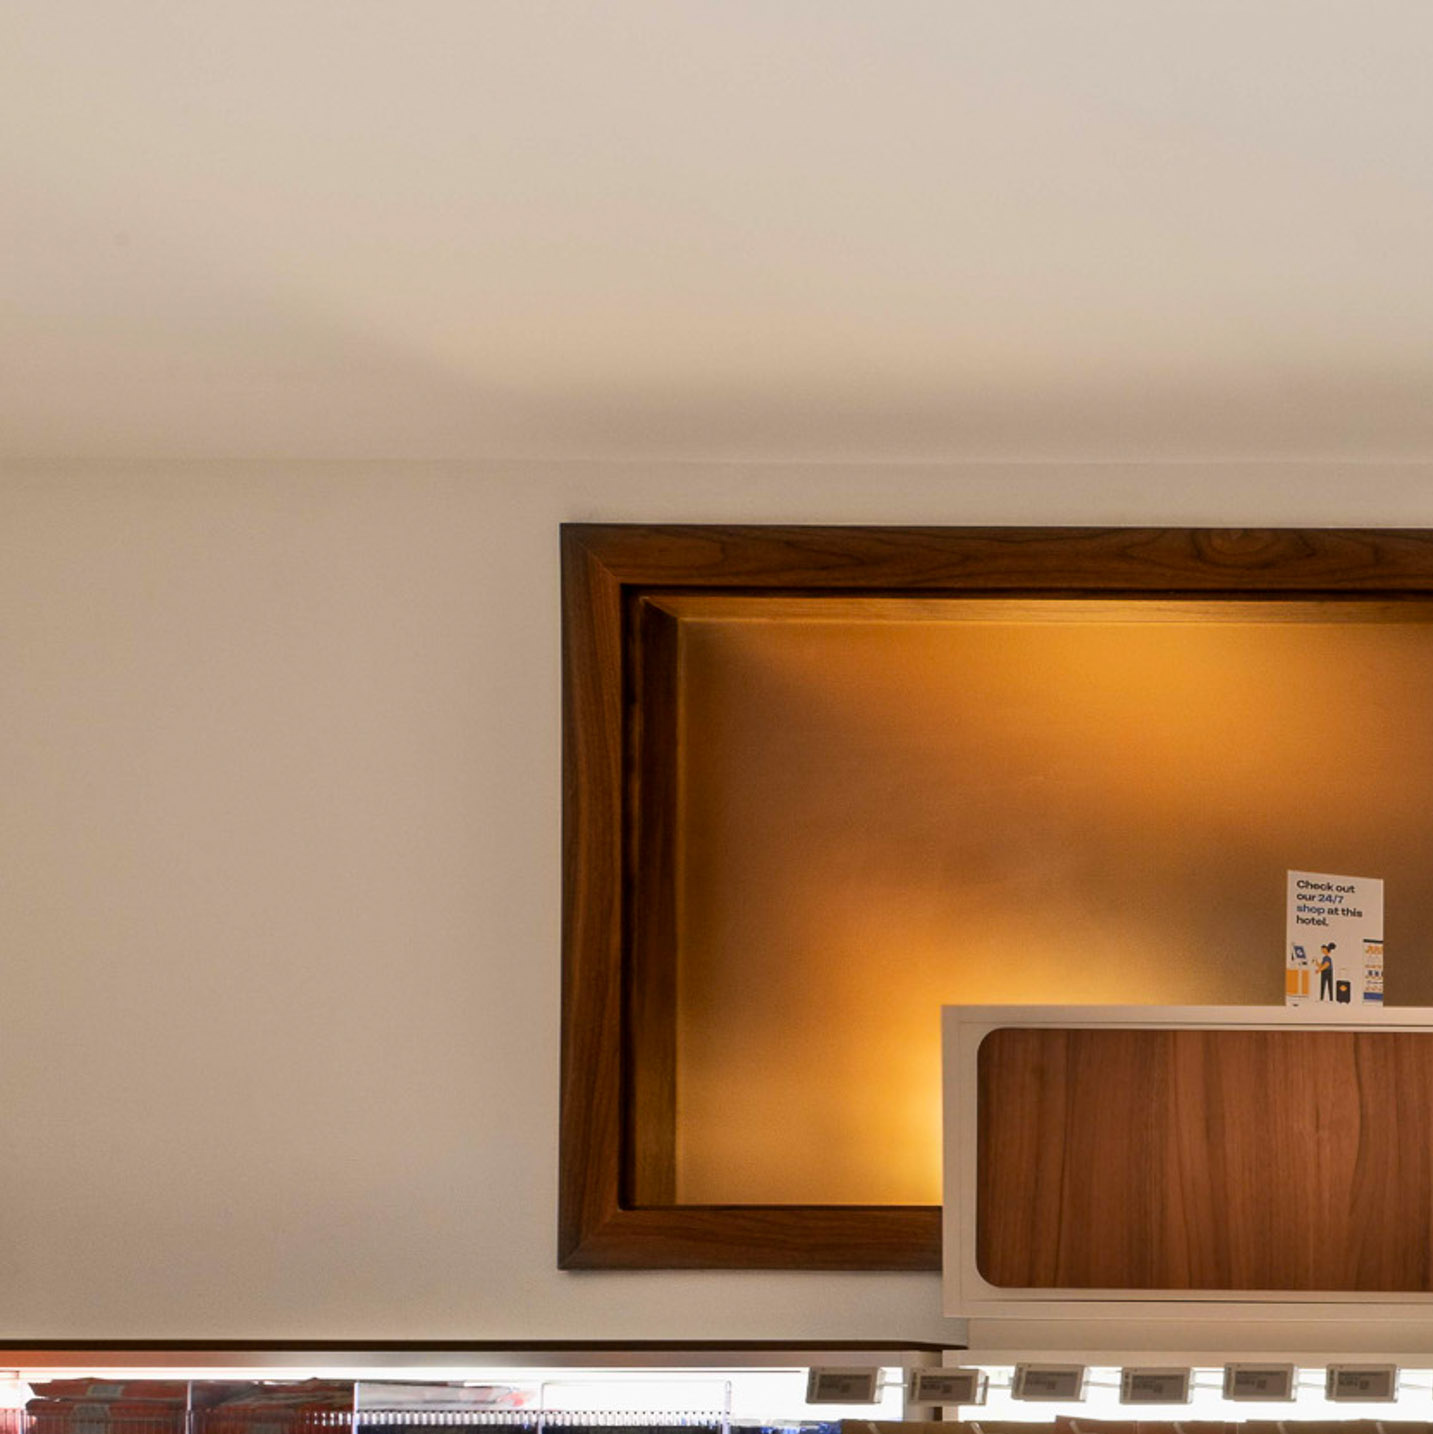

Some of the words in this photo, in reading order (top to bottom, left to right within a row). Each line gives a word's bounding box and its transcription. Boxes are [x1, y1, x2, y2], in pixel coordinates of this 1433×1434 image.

[1296, 880, 1334, 892] Check
[1336, 884, 1355, 893] out
[1296, 893, 1316, 901] our
[1318, 894, 1344, 903] 24/7
[1296, 904, 1325, 915] shop
[1327, 907, 1339, 916] at
[1341, 908, 1363, 917] this
[1296, 915, 1329, 927] hotel.
